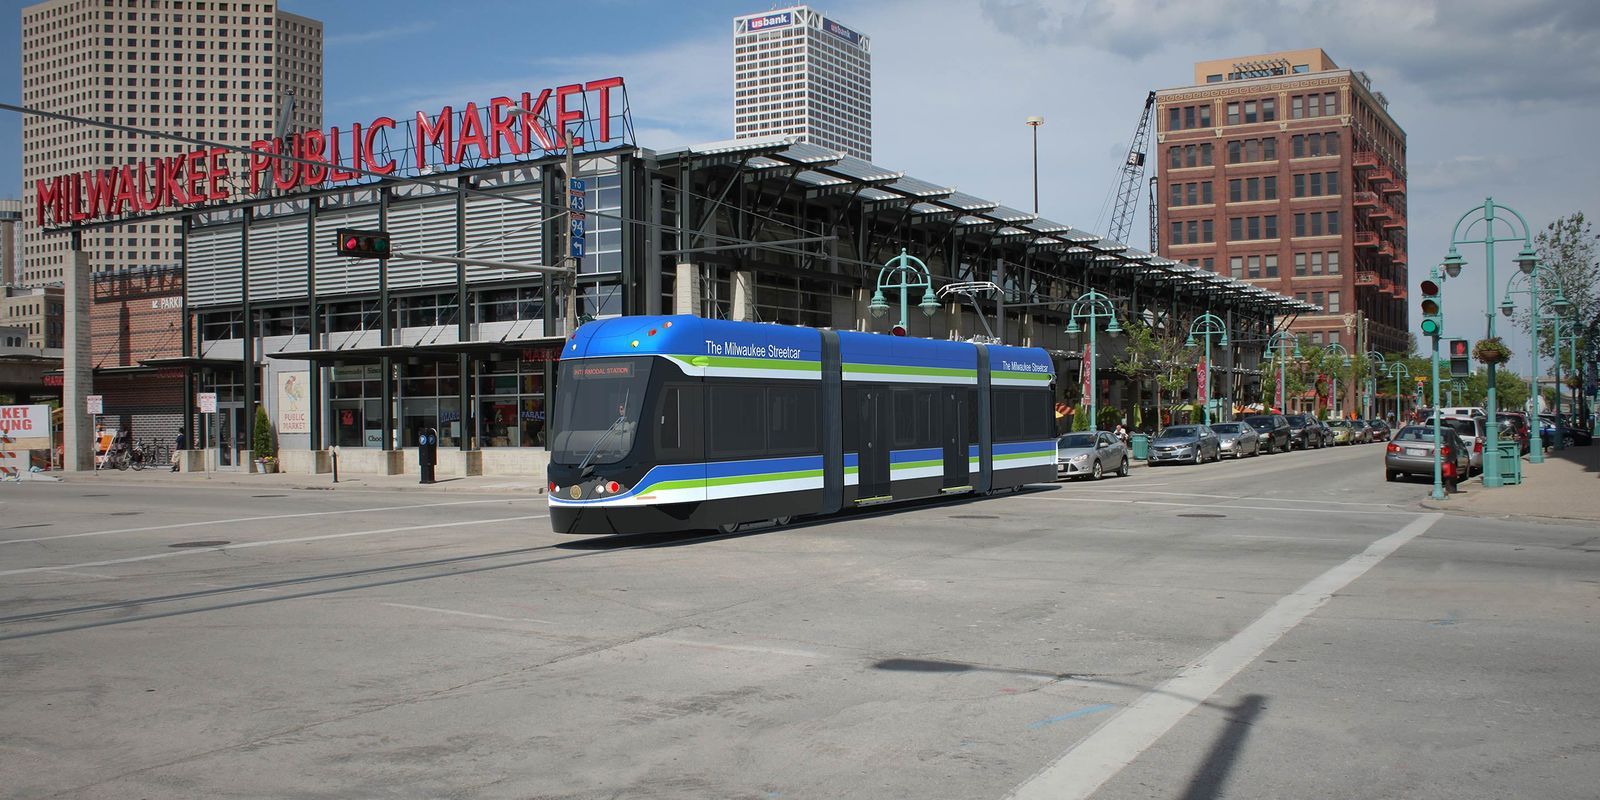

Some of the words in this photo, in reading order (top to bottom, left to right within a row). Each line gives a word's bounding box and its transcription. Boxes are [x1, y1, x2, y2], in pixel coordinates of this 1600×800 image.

[751, 14, 789, 29] usbank
[37, 147, 230, 226] MILWAUKEE
[251, 117, 396, 194] PUBLIC
[416, 77, 624, 169] MARKET
[573, 181, 582, 189] TO
[571, 196, 584, 210] 43
[571, 220, 584, 232] 94
[706, 340, 722, 355] The
[724, 341, 766, 357] Milwaukee
[768, 344, 801, 359] Streetcar
[1002, 360, 1011, 371] The
[1011, 361, 1031, 372] Milwaukee
[1031, 362, 1049, 373] Streetcar
[2, 407, 29, 418] KET
[284, 413, 305, 421] PUBLIC
[283, 422, 306, 431] MARKET
